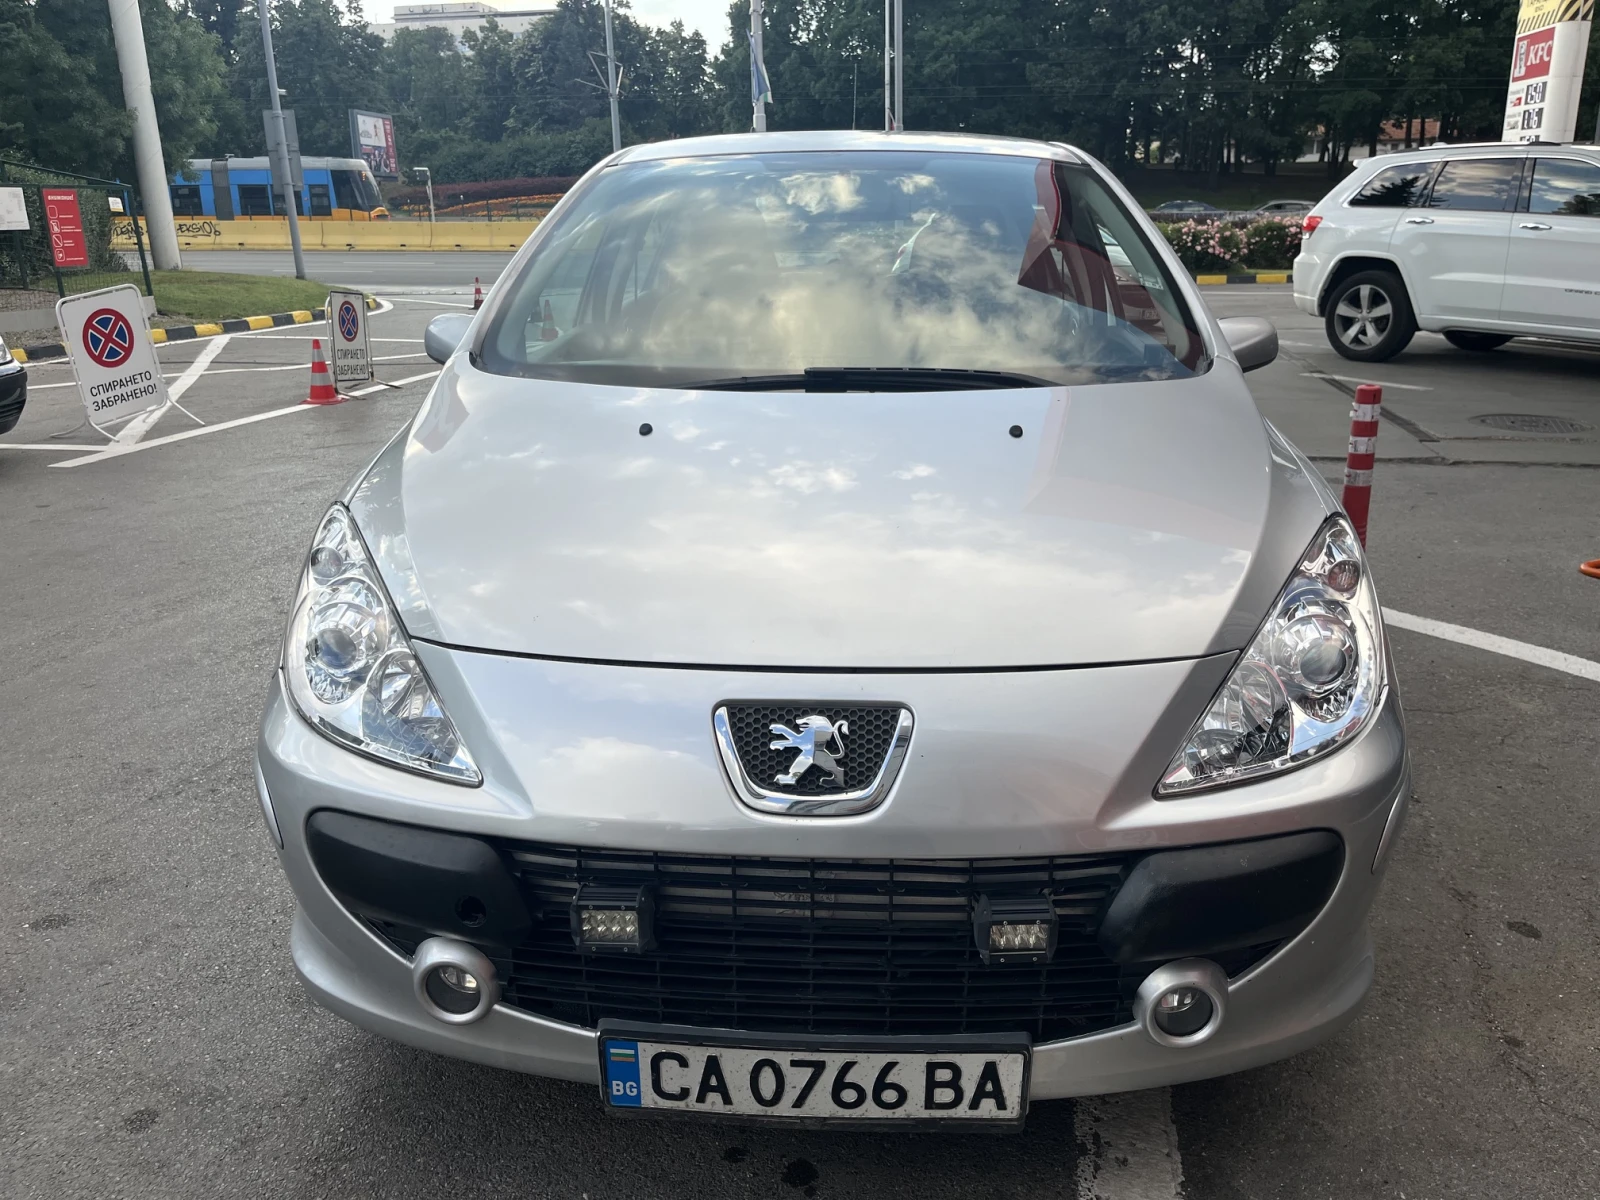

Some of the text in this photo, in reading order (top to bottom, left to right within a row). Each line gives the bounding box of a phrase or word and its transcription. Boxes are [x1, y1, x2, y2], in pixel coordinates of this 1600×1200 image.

[1526, 40, 1552, 66] KFC
[337, 348, 366, 360] СПИРАНЕТО
[90, 370, 152, 397] СПИРАНЕТО
[92, 383, 158, 412] ЗАБРАНЕНО!
[612, 1081, 638, 1097] BG
[650, 1051, 1007, 1110] CA 0766 BA
